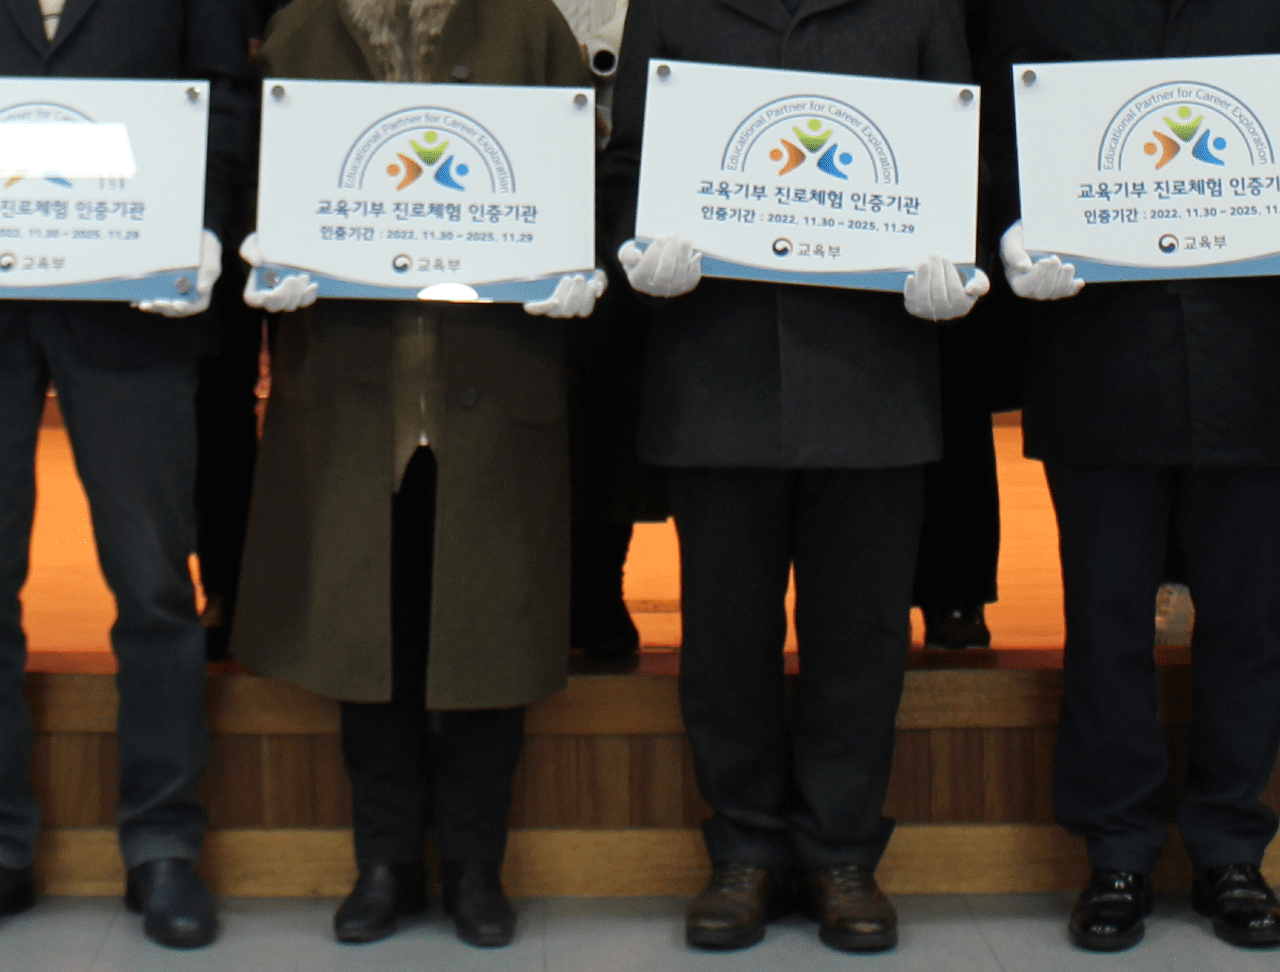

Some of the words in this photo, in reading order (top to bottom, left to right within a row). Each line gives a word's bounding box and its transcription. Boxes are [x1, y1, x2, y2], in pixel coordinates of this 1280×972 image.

[1103, 108, 1137, 169] Educational
[1134, 90, 1173, 112] Partner
[1176, 87, 1192, 97] for
[1196, 89, 1232, 109] Career
[1231, 105, 1267, 164] Exploration
[727, 114, 767, 170] Educational
[765, 103, 806, 119] Partner
[808, 100, 825, 111] for
[828, 105, 862, 126] Career
[861, 124, 891, 183] Exploration
[698, 181, 767, 200] 교육기부
[775, 187, 843, 209] 진로체험
[850, 193, 920, 215] 인증기관
[1078, 182, 1147, 201] 교육기부
[1154, 178, 1222, 199] 진로체험
[316, 200, 385, 218] 교육기부
[393, 202, 461, 221] 진로체험
[468, 204, 538, 223] 인증기관
[701, 206, 755, 223] 인증기간
[768, 213, 799, 224] 2022.
[804, 216, 835, 227] 11.30
[848, 220, 880, 230] 2025.
[884, 223, 915, 233] 11.29
[1084, 208, 1138, 224] 인증기간
[1151, 209, 1181, 219] 2022.
[1186, 207, 1217, 217] 11.30
[1230, 206, 1261, 216] 2025.
[321, 226, 374, 241] 인증기간
[423, 231, 454, 240] 11.30
[503, 233, 533, 242] 11.29
[1185, 235, 1226, 250] 교육부
[798, 243, 840, 258] 교육부
[418, 258, 460, 272] 교육부
